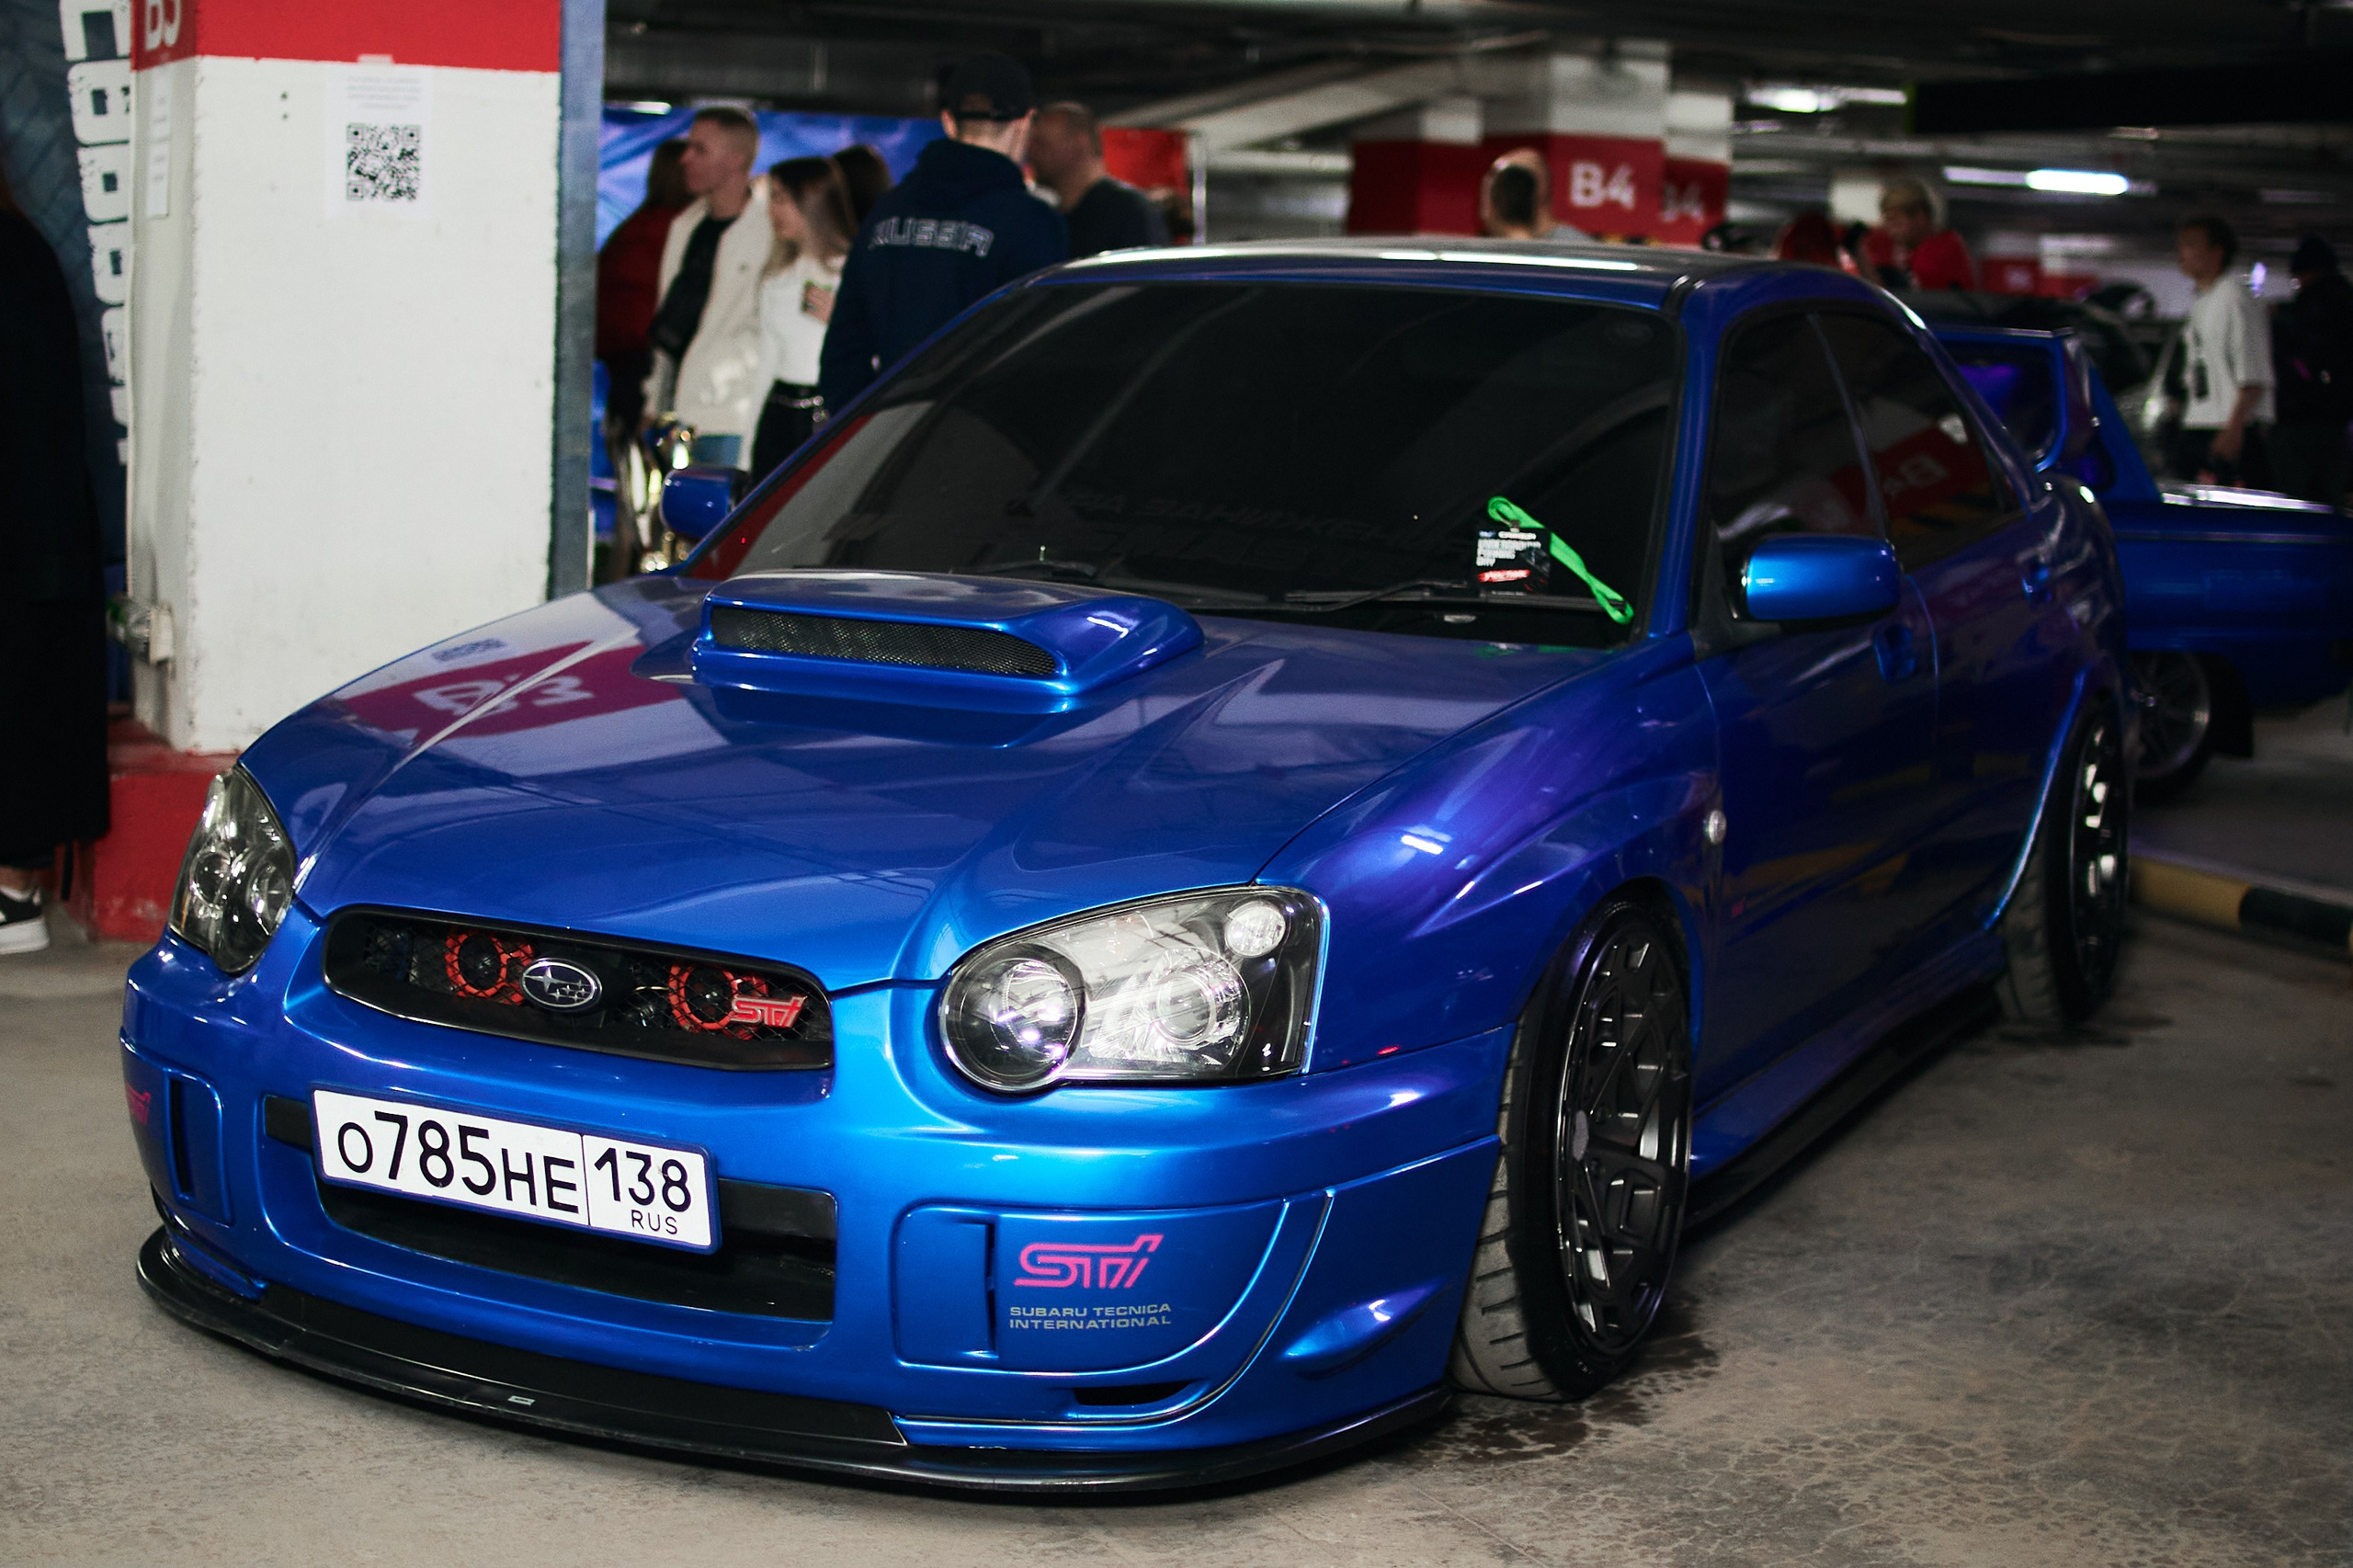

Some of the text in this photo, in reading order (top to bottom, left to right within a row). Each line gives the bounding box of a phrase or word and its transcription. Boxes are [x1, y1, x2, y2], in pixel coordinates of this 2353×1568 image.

[1570, 162, 1635, 210] B4
[594, 1147, 691, 1212] 138
[631, 1209, 678, 1235] RUS
[1009, 1315, 1172, 1329] INTERNATIONAL
[1010, 1302, 1172, 1317] SUBARU TECNICA
